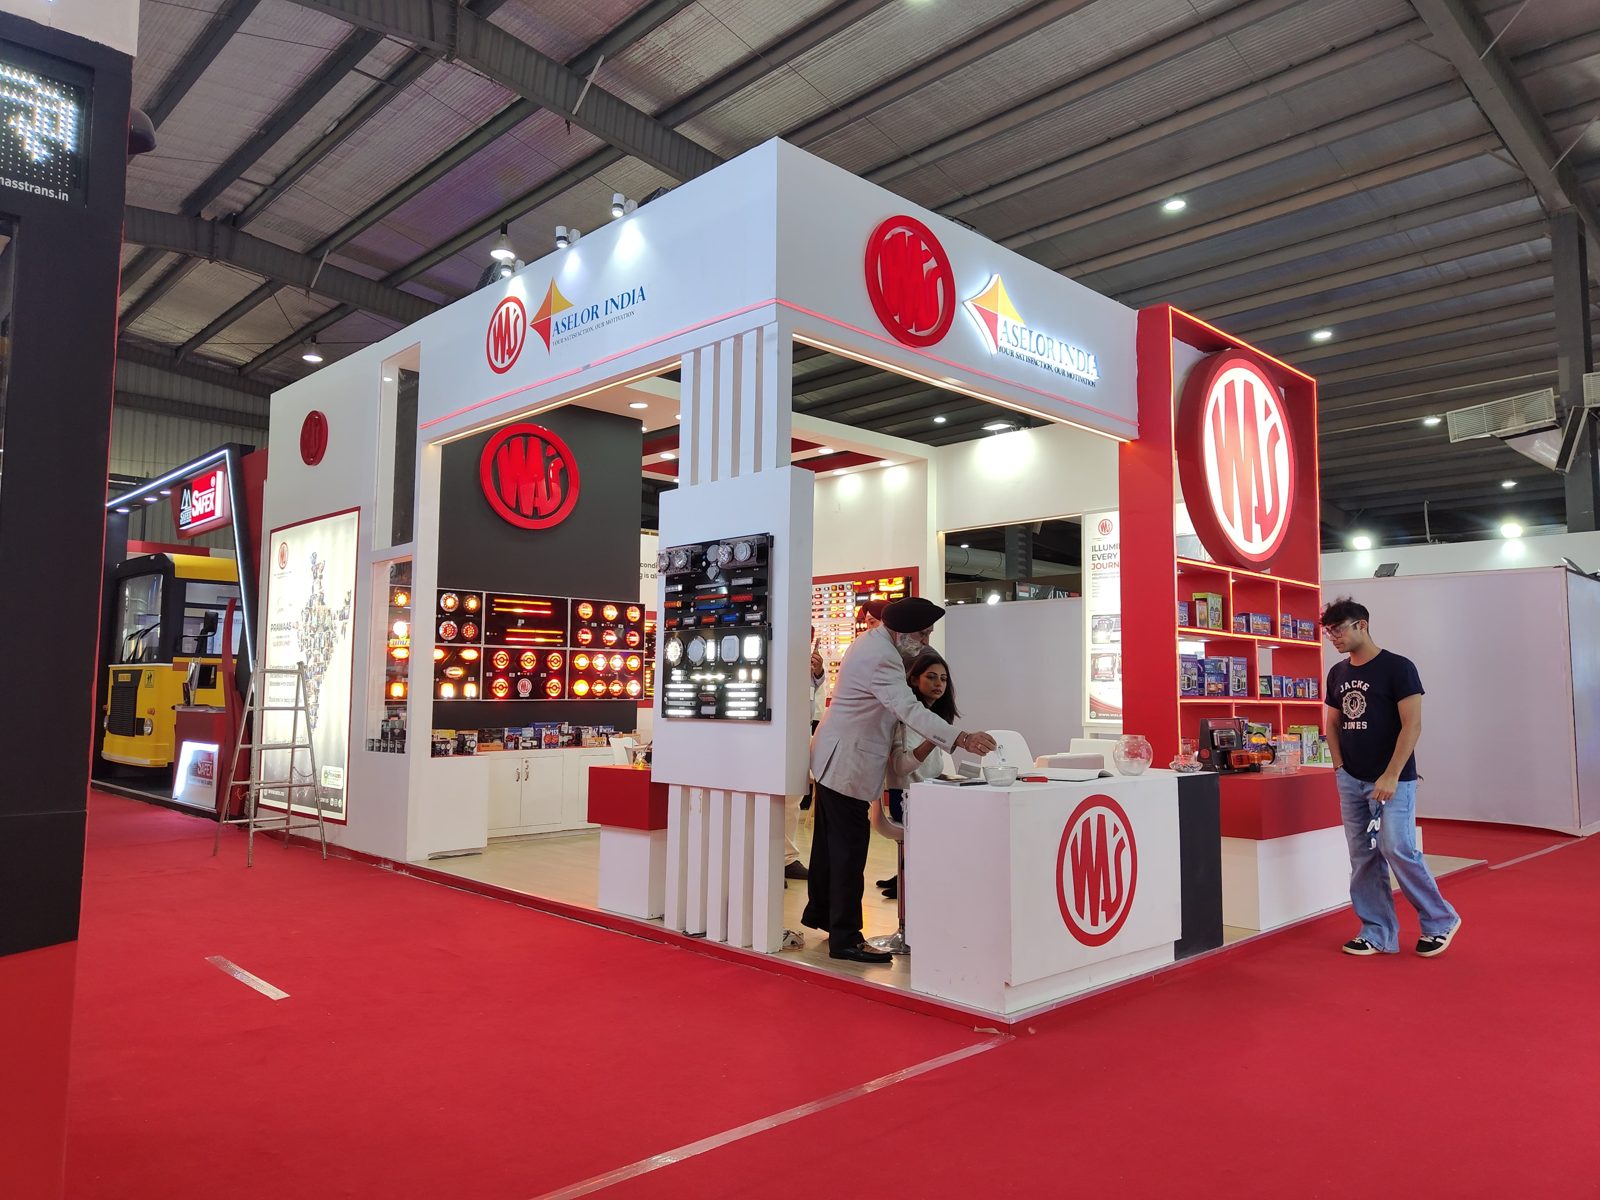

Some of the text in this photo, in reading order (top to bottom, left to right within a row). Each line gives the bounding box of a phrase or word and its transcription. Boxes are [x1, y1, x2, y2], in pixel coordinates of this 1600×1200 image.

[551, 285, 647, 338] ASELOR INDIA
[594, 322, 605, 331] OUR
[606, 310, 635, 326] MOTIVATION
[1000, 319, 1101, 380] ASELOR INDIA
[998, 345, 1015, 358] YOUR
[1054, 365, 1067, 377] OUR
[1066, 371, 1097, 388] MOTIVATION
[192, 488, 216, 518] SAFEX
[1091, 552, 1118, 562] EVERY
[1342, 721, 1368, 730] JONES
